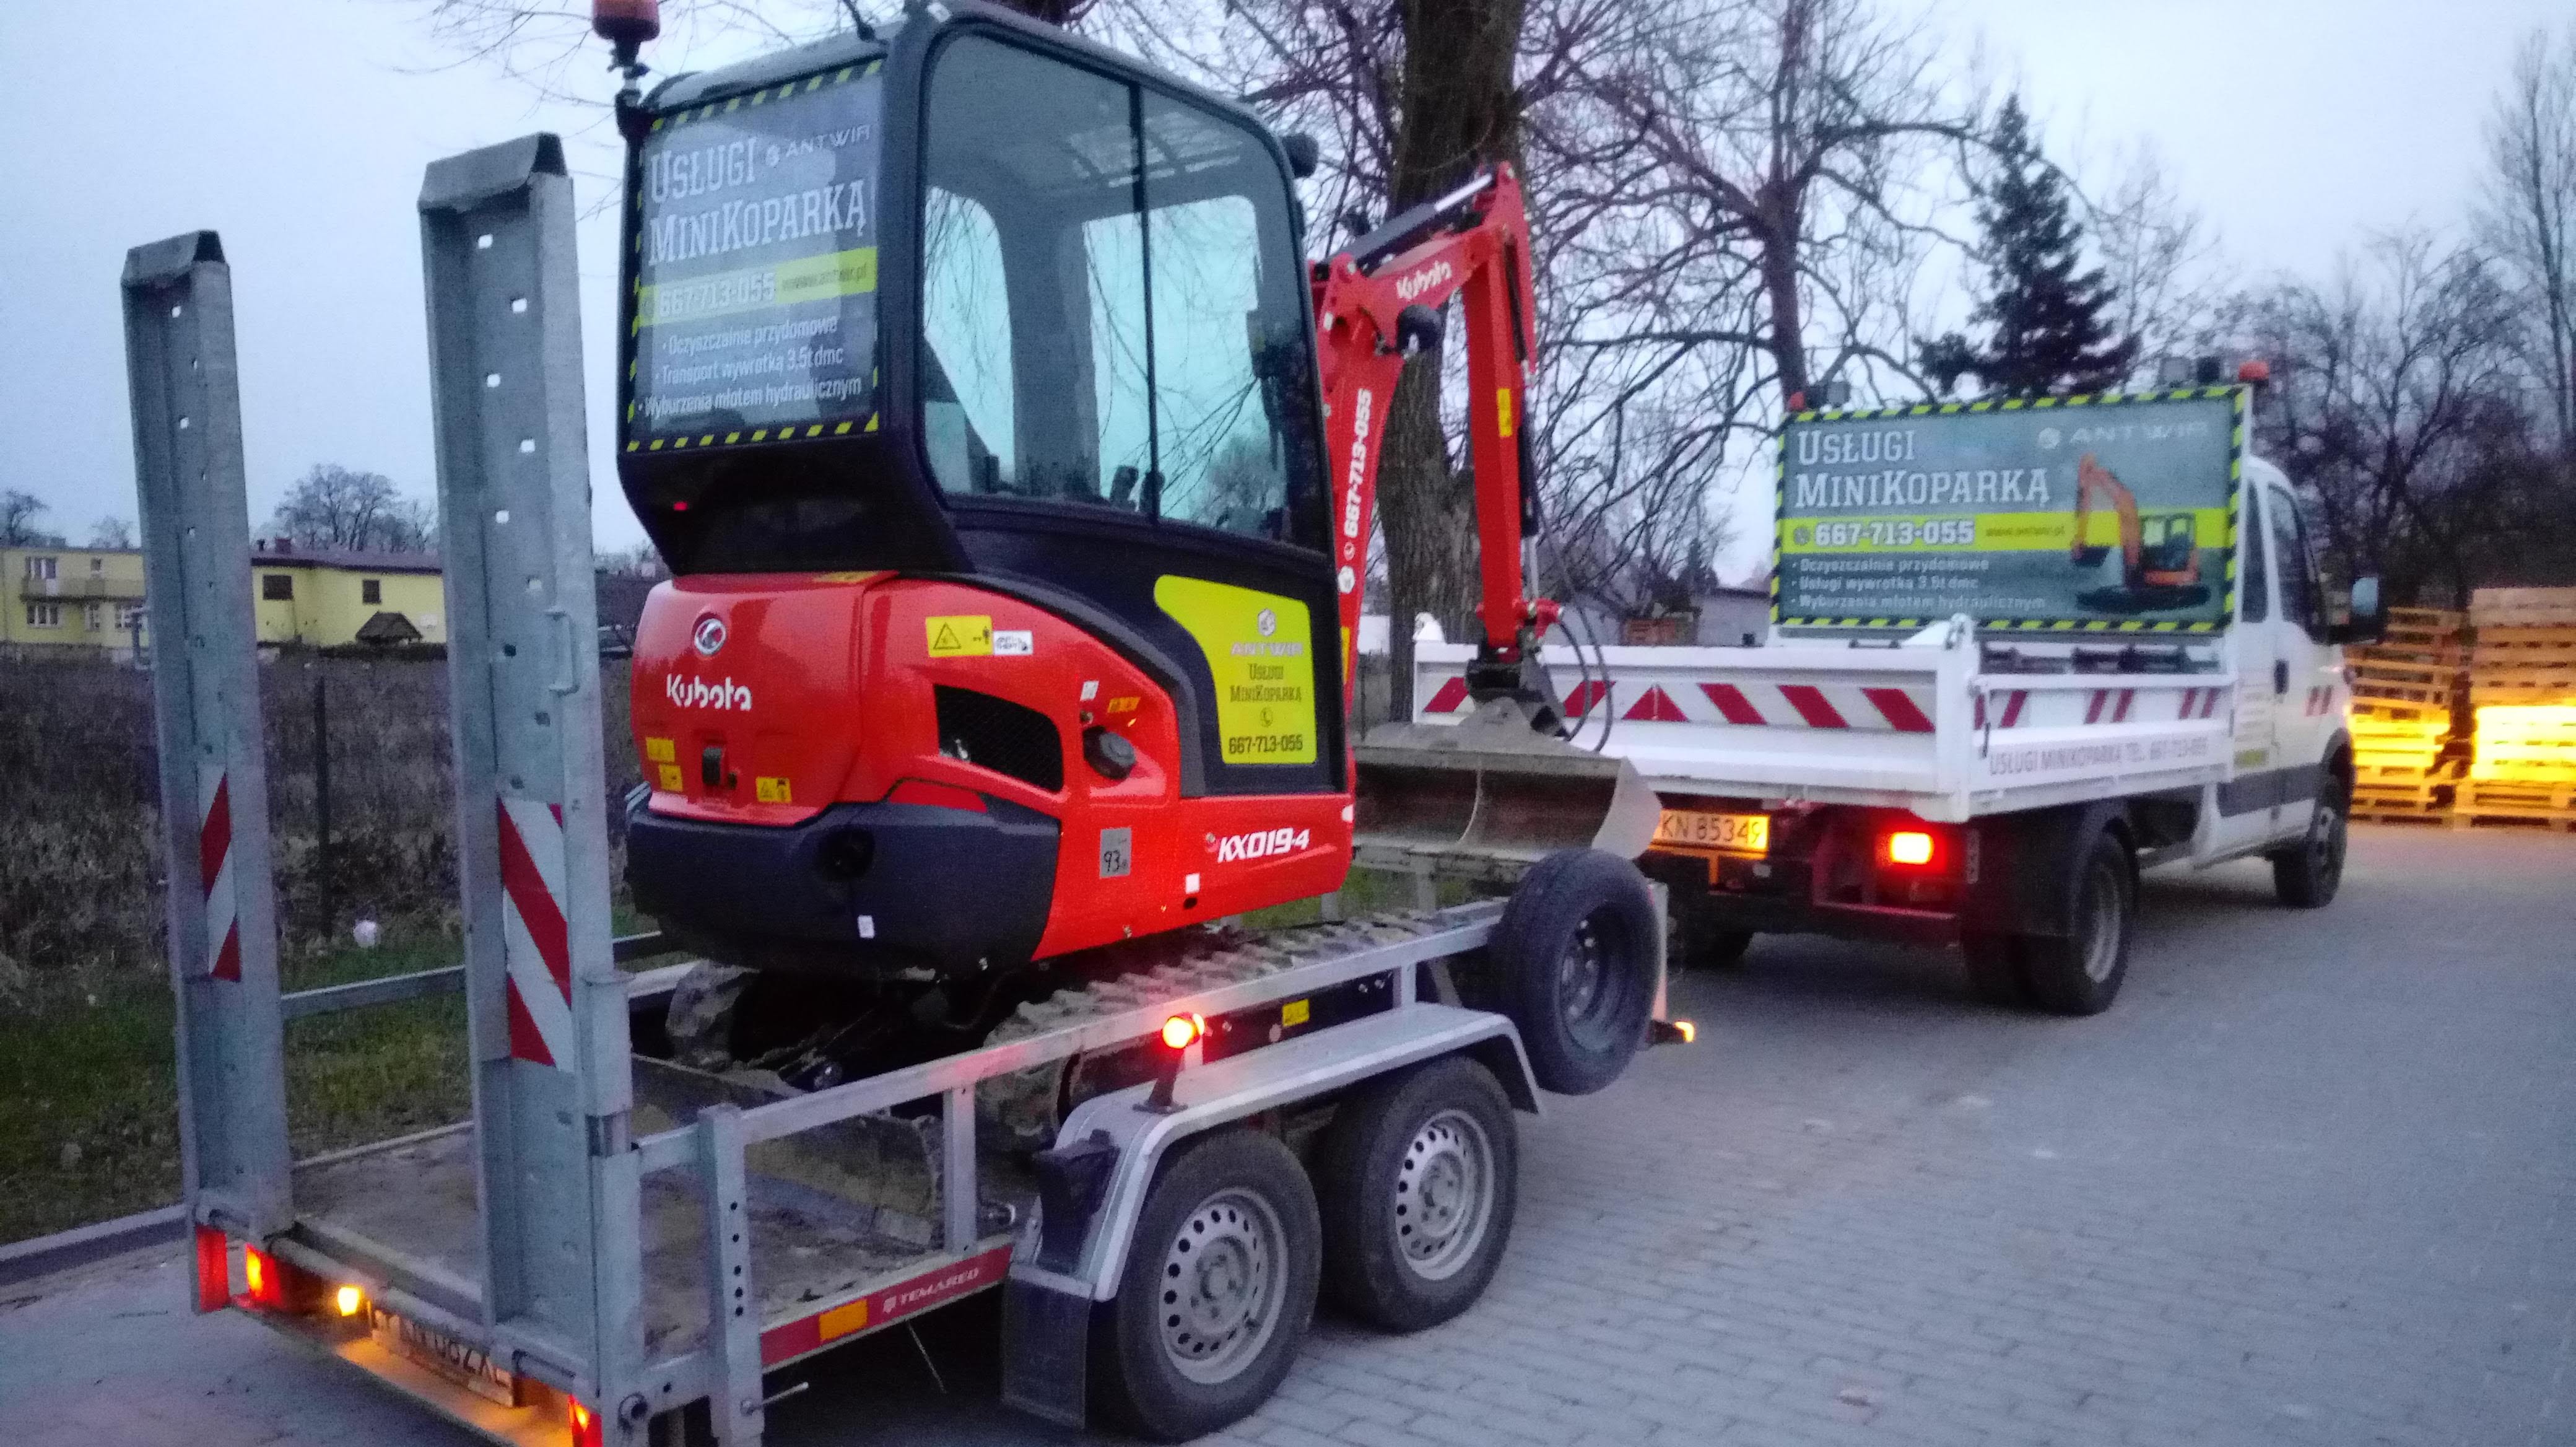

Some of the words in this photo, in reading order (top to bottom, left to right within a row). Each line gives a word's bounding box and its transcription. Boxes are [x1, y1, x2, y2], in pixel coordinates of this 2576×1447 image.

[659, 273, 775, 317] 667-713-055
[1396, 260, 1453, 301] Kubota
[1814, 519, 1975, 546] 667-713-055
[666, 673, 752, 711] Kubota
[1229, 735, 1303, 754] 667-713-055
[1660, 814, 1689, 837] KN
[1217, 828, 1310, 863] KX019-4
